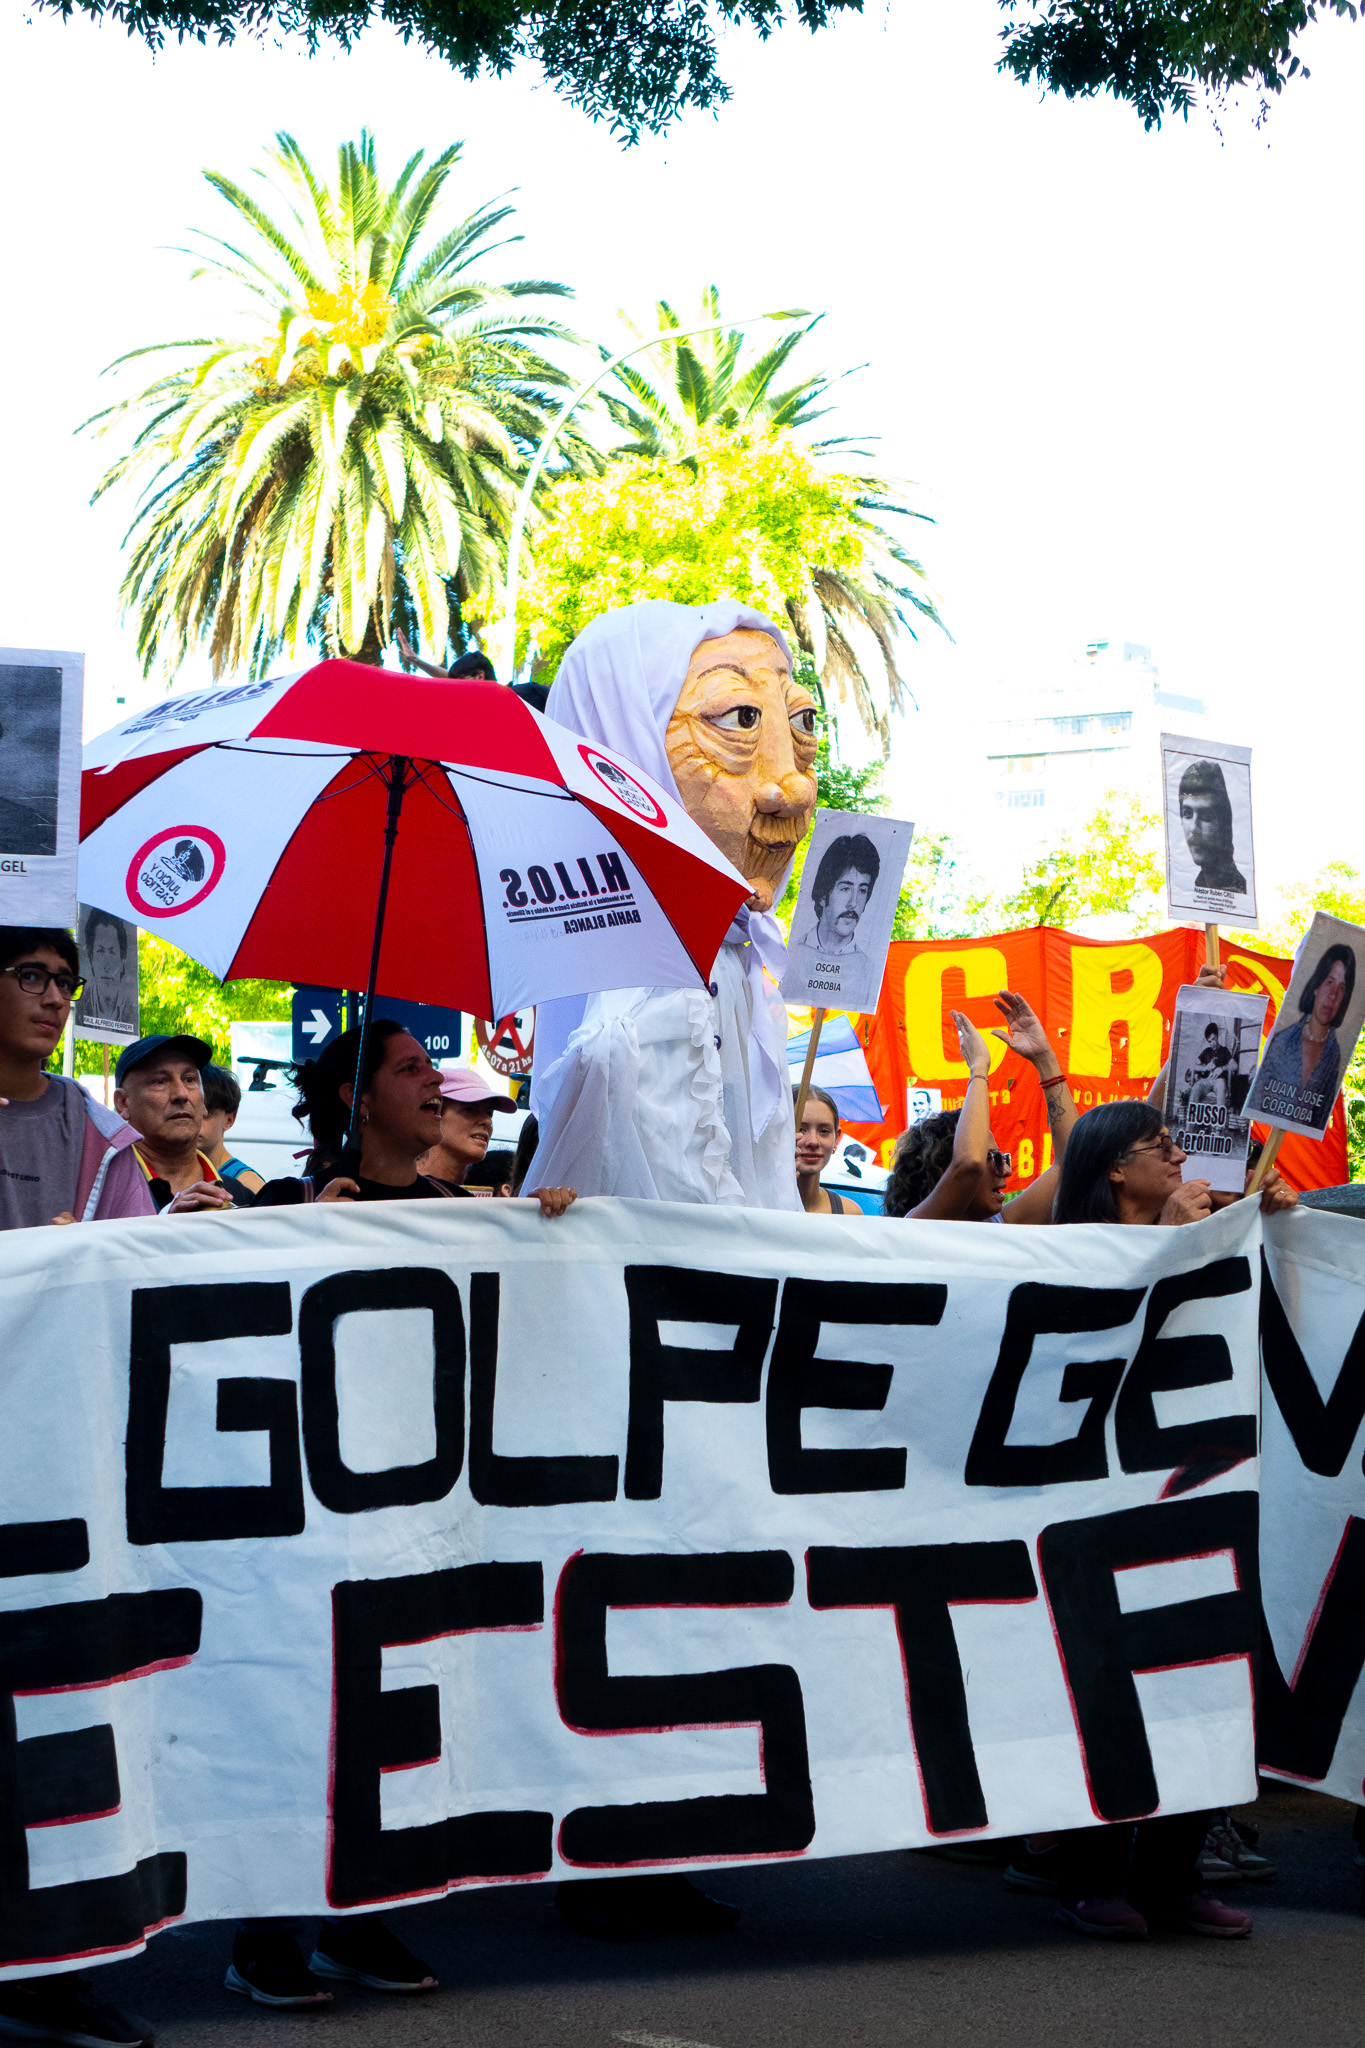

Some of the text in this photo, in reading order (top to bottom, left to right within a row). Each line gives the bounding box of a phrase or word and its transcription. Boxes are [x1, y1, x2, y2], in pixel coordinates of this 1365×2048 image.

[816, 963, 840, 973] OSCAR
[808, 980, 841, 991] BOROBIA
[424, 1035, 450, 1050] 100
[509, 1061, 521, 1073] 21
[1264, 1079, 1325, 1107] JUAN JOSE
[1187, 1102, 1227, 1127] RUSSO
[1262, 1096, 1313, 1123] CORDOBA
[125, 1243, 1365, 1545] GOLPE GEN
